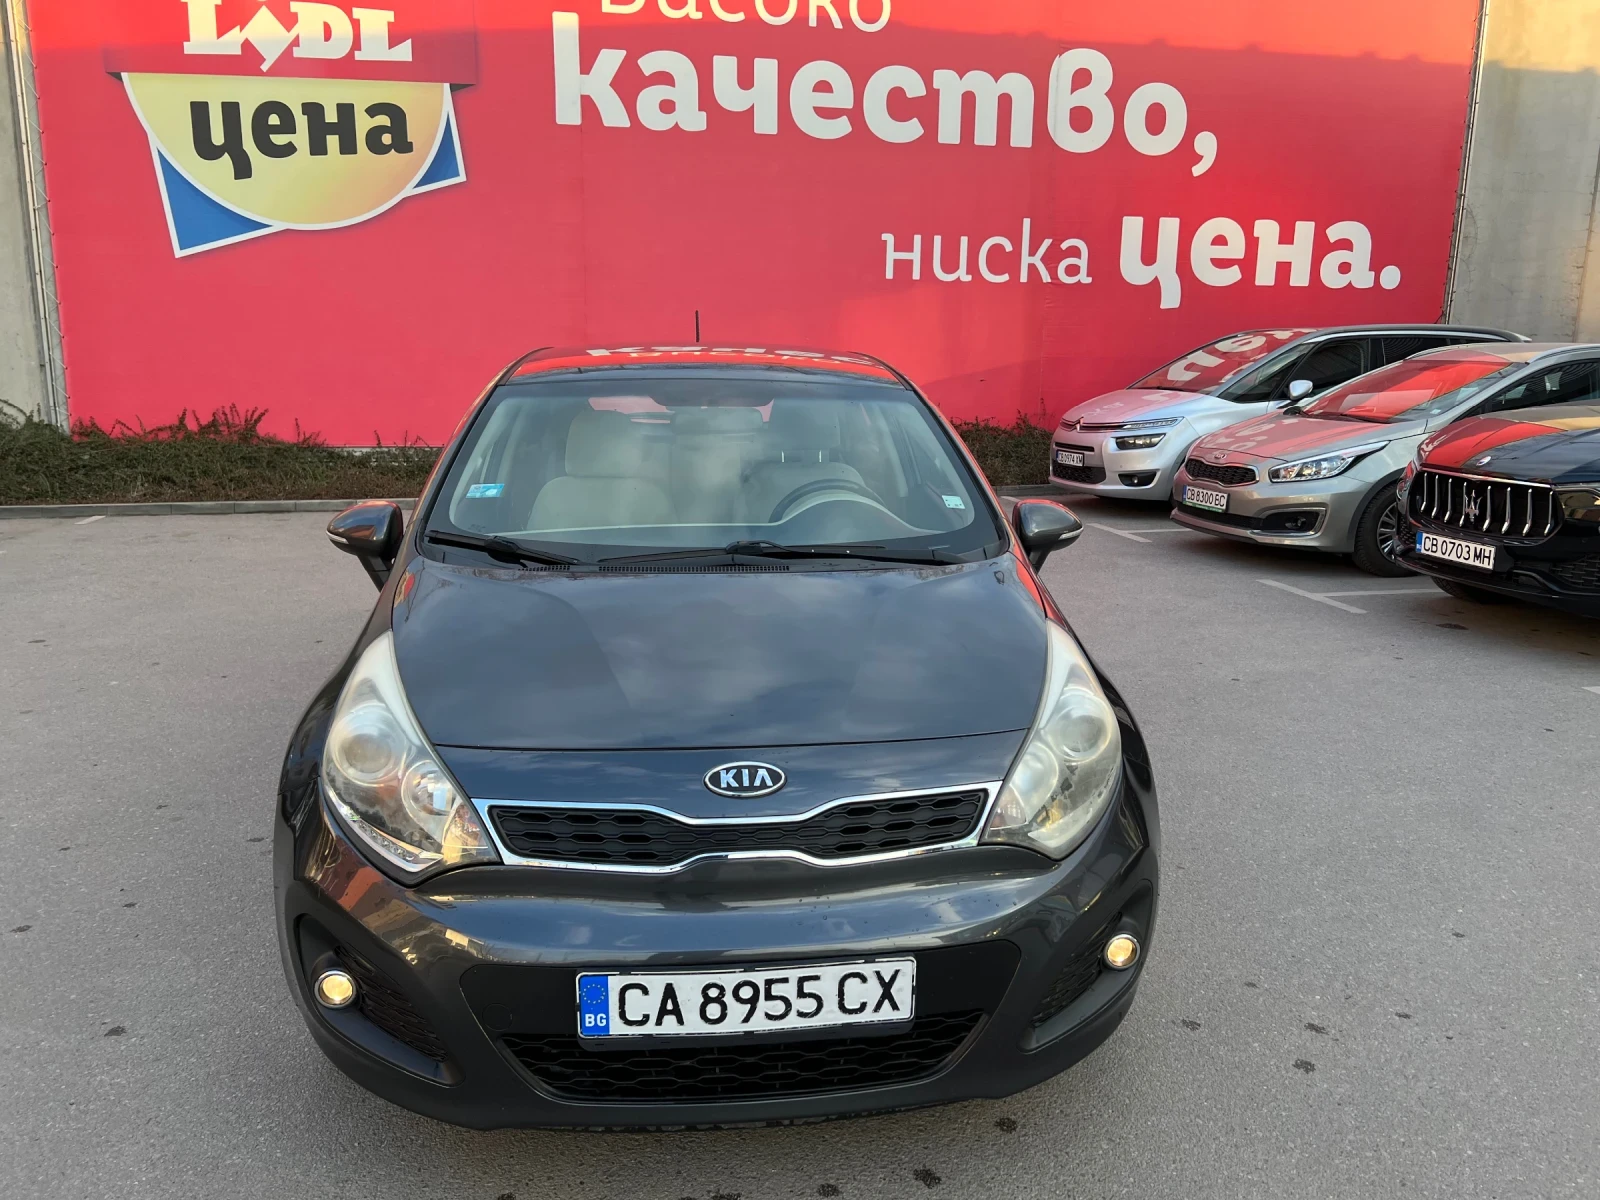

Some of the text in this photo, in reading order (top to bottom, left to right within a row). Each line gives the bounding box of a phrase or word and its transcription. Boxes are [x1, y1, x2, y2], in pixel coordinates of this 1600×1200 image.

[552, 11, 1218, 177] качество,
[190, 100, 414, 181] цена
[882, 216, 1401, 309] ниска цена.
[1196, 490, 1214, 505] 8300
[1423, 536, 1492, 566] CB 0703 MH
[719, 768, 774, 788] KIA
[618, 968, 901, 1027] CA 8955 CX
[585, 1013, 607, 1027] BG
